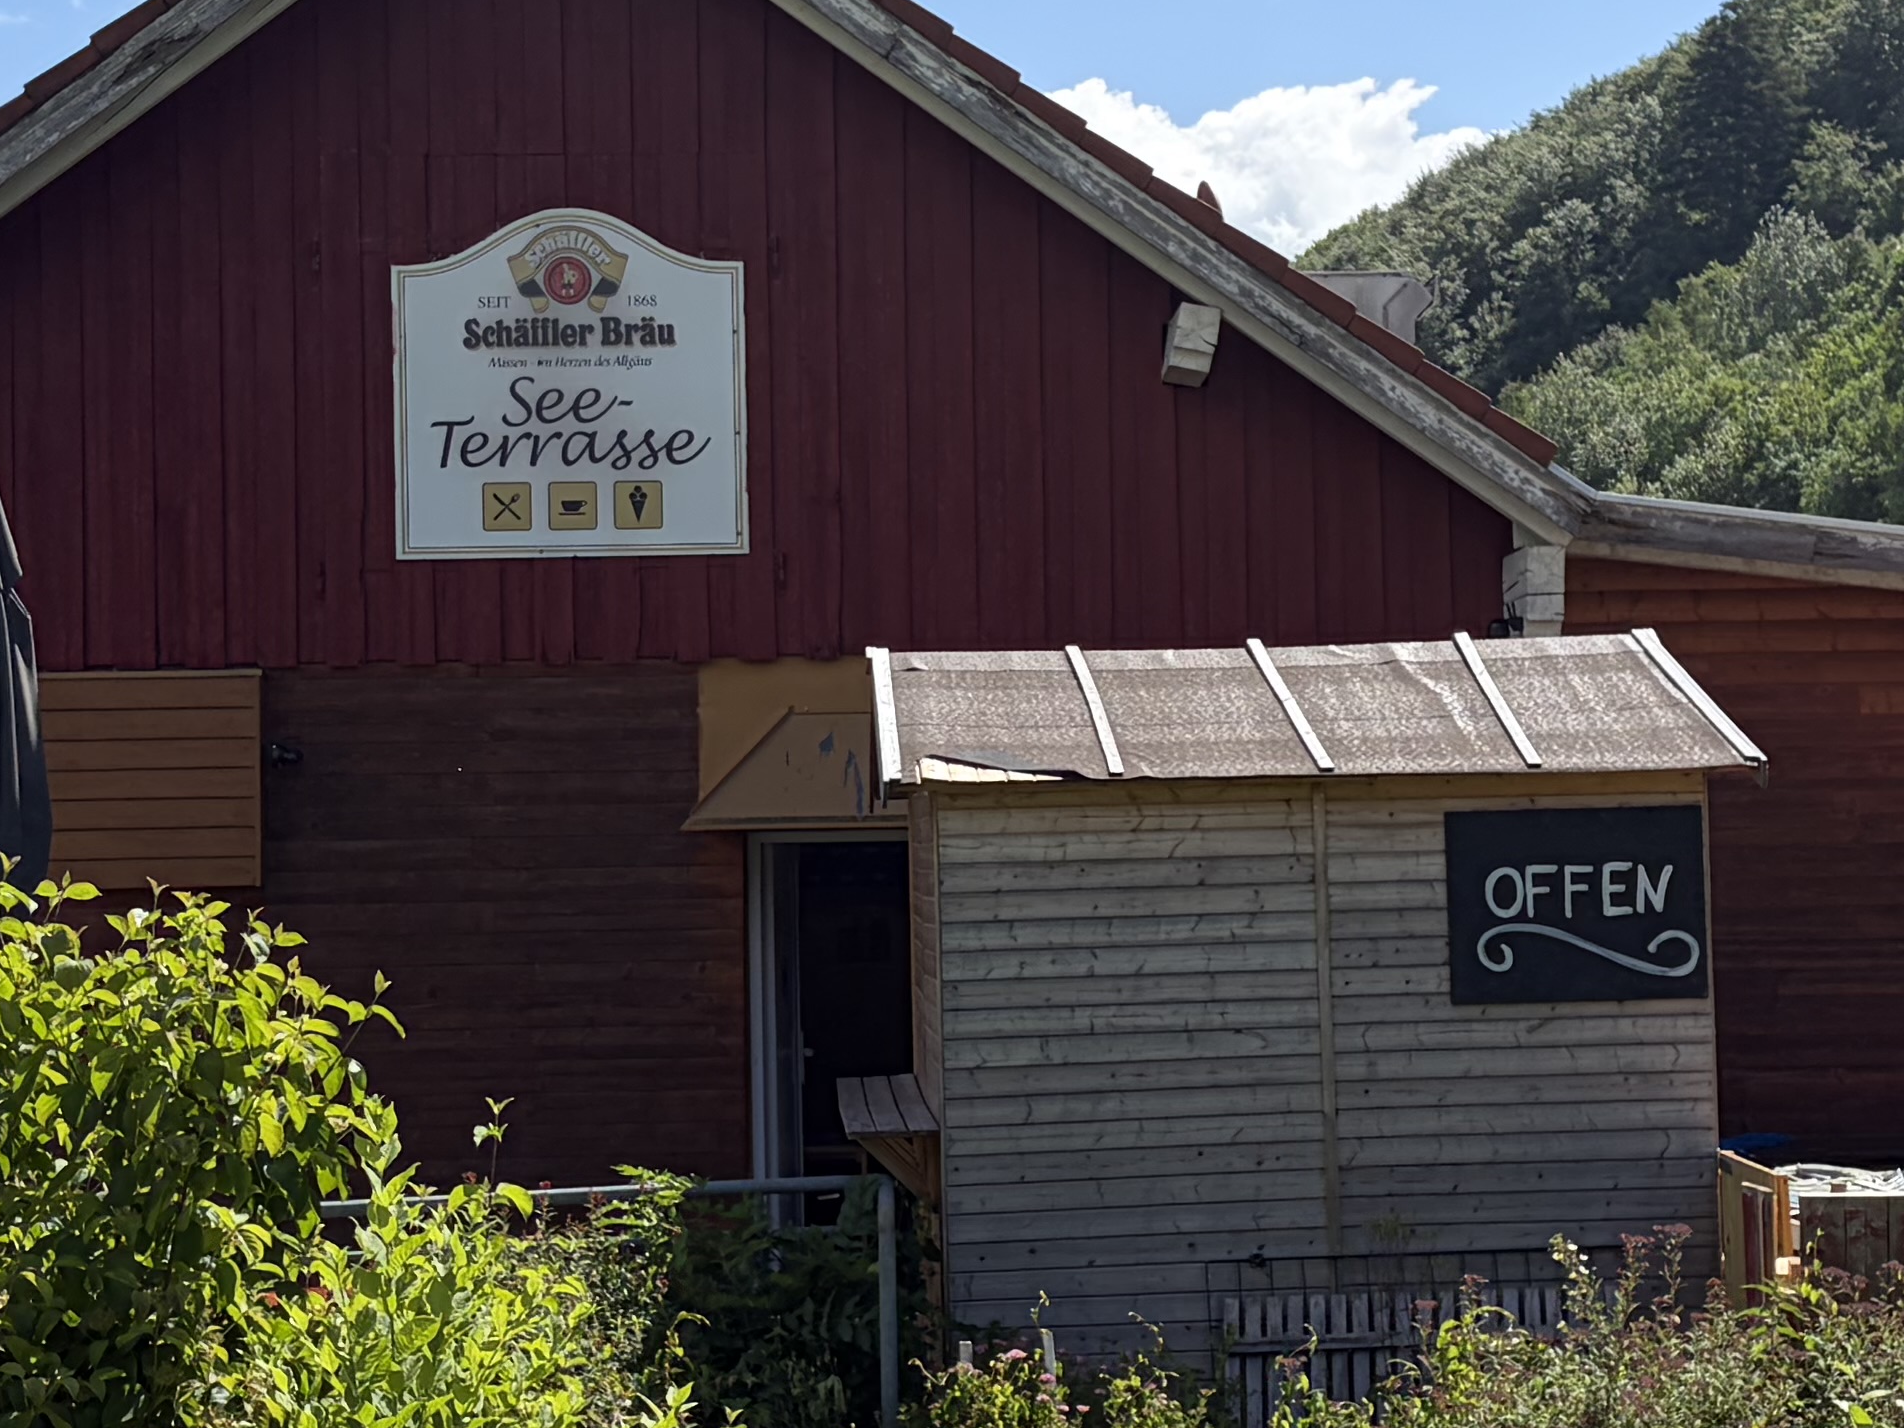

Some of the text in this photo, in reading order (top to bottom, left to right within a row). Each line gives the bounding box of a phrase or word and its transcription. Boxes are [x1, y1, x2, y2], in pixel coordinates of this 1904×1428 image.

[477, 294, 658, 309] SEIT 1868
[462, 315, 677, 350] Schäffler Bräu
[488, 356, 528, 368] Missen
[554, 356, 592, 368] Herzen
[594, 355, 611, 368] des
[613, 354, 653, 370] Allgäus
[501, 375, 635, 428] See-
[429, 414, 713, 471] Terrasse
[1484, 861, 1674, 919] OFFEN
